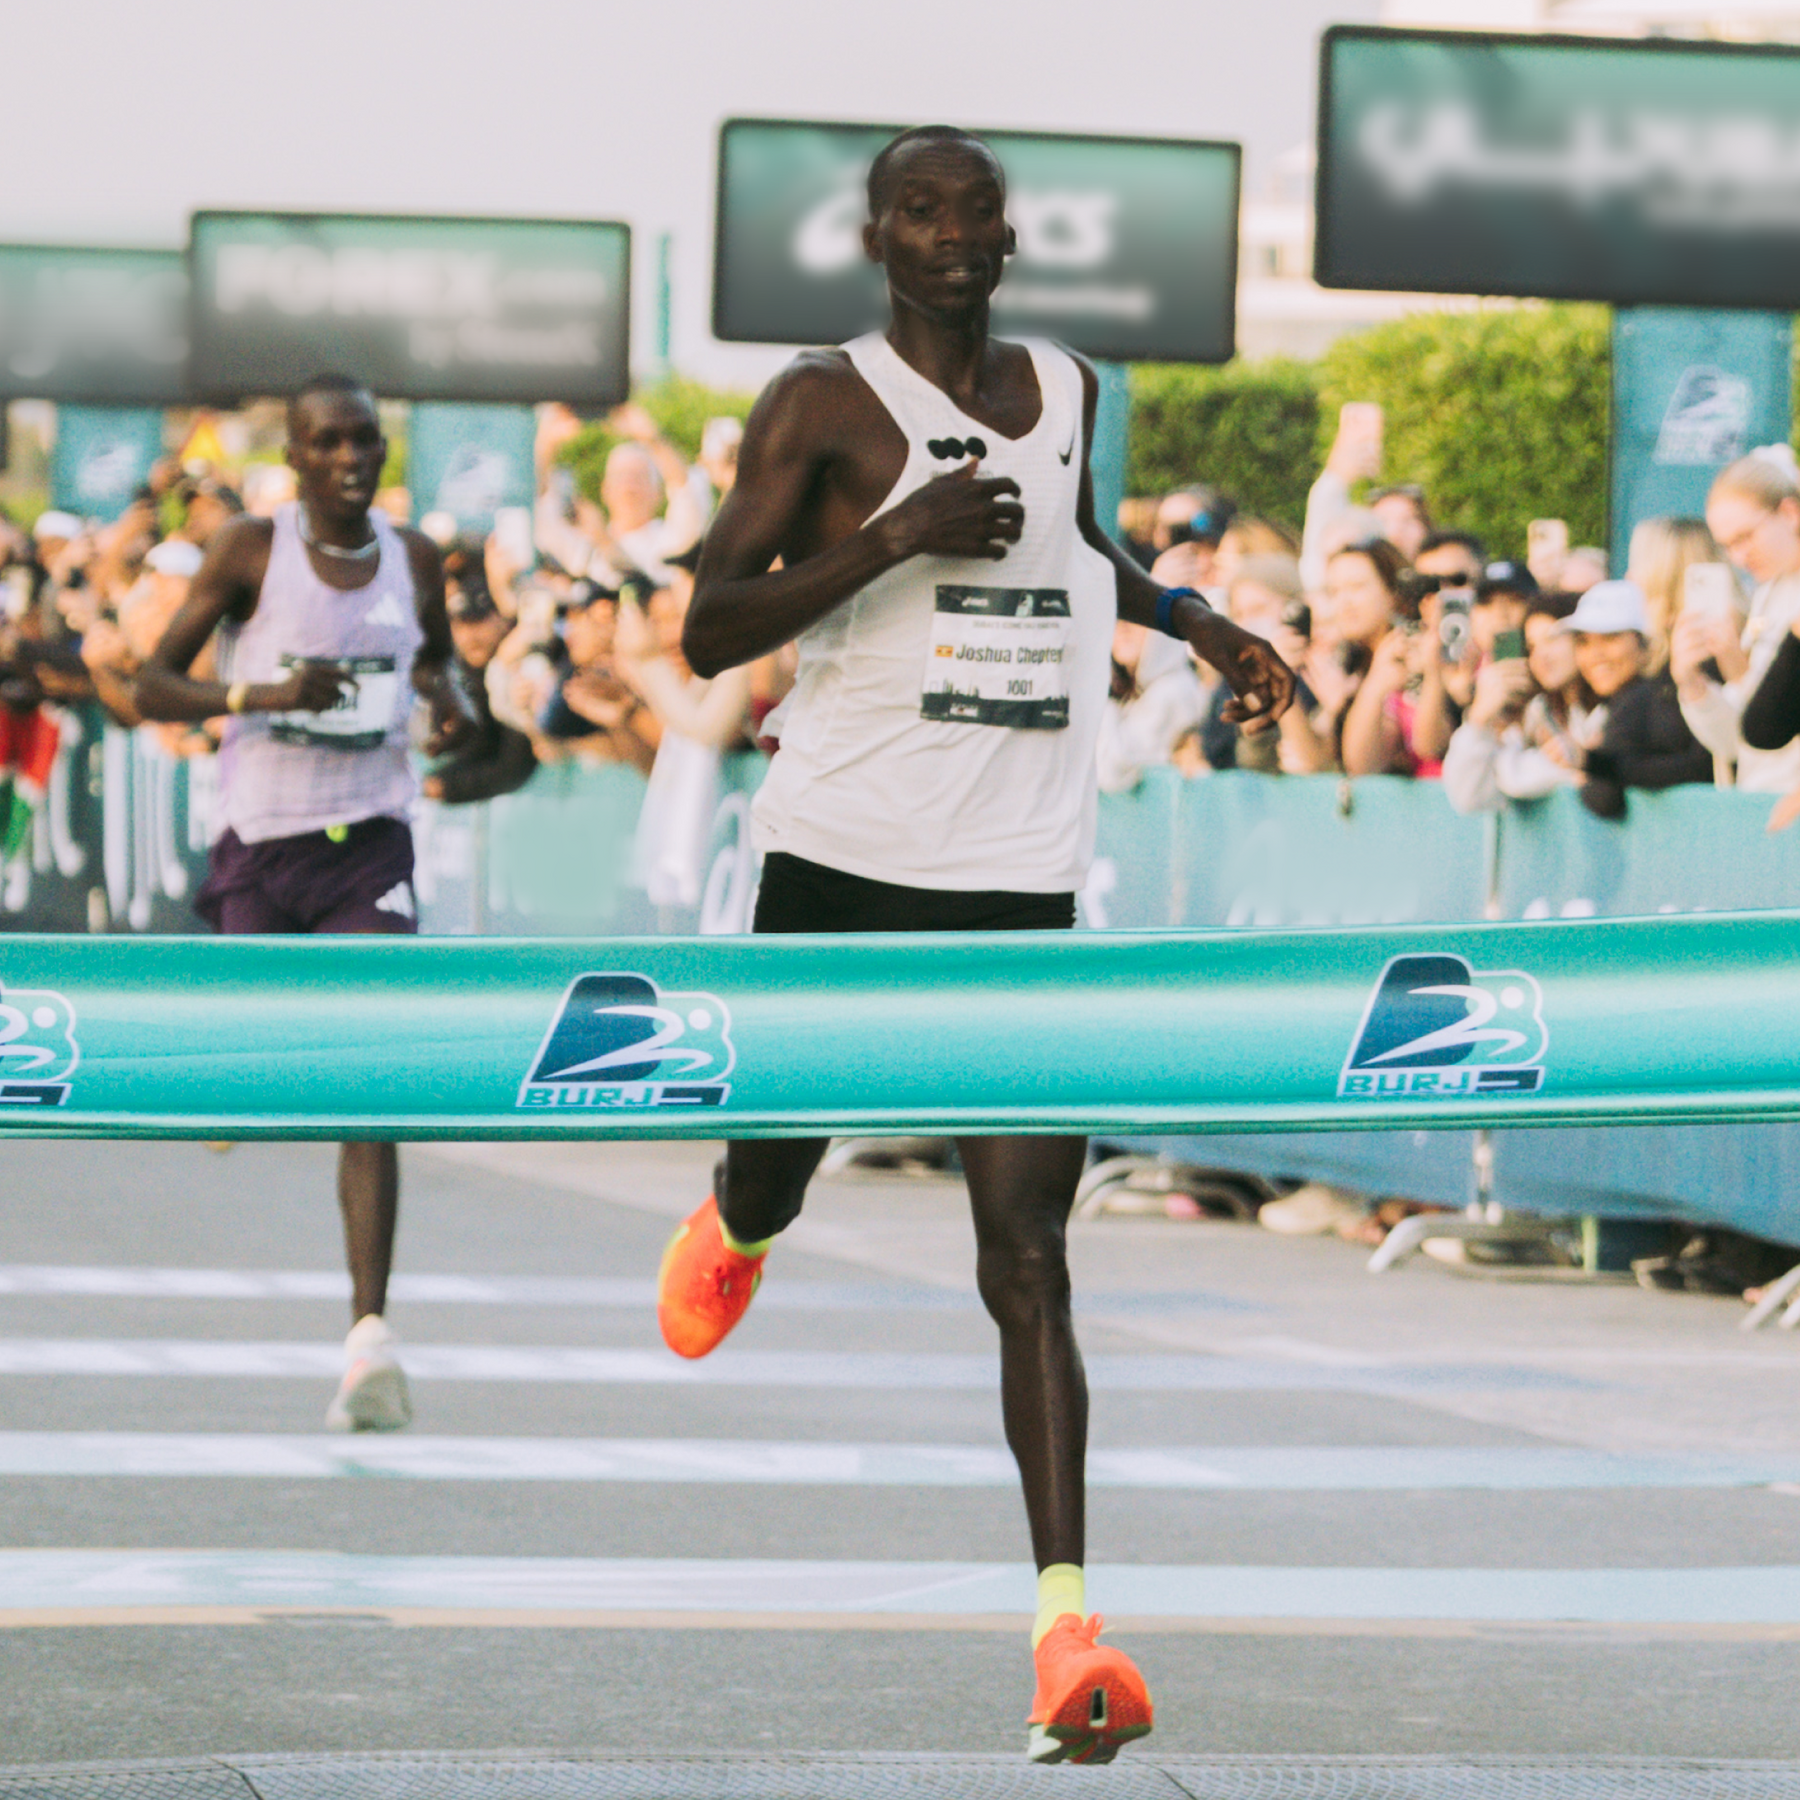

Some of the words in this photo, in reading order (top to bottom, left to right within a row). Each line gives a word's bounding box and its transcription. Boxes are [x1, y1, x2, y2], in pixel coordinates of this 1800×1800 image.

[956, 645, 1012, 663] Joshua
[1007, 679, 1033, 695] 1001
[1343, 1071, 1470, 1093] BURJ
[522, 1087, 654, 1106] BURJ
